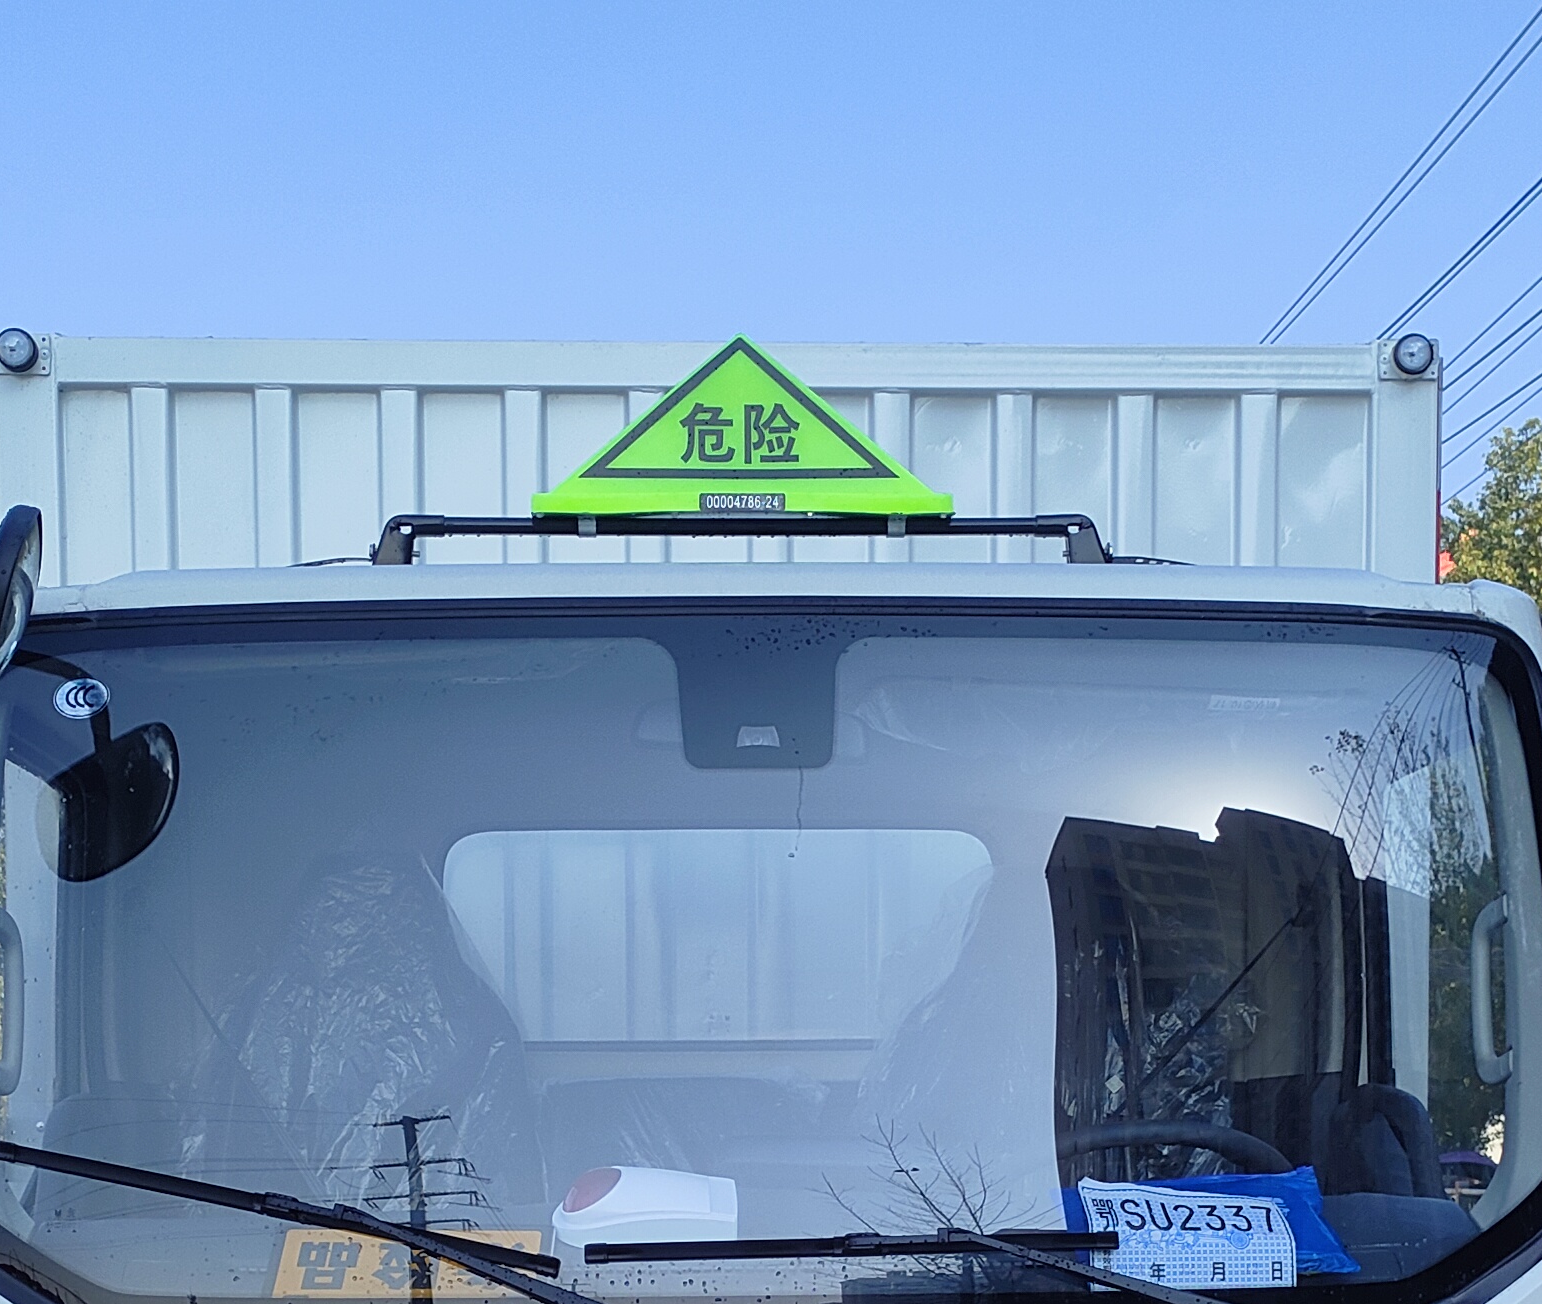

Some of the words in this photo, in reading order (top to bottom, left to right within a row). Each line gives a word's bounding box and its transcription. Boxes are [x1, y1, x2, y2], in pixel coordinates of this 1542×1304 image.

[680, 402, 801, 465] 危险
[706, 495, 779, 509] 00004786-24
[65, 684, 96, 709] CCC
[1150, 1262, 1166, 1281] 年
[1210, 1261, 1226, 1281] 月
[1271, 1261, 1283, 1281] 日
